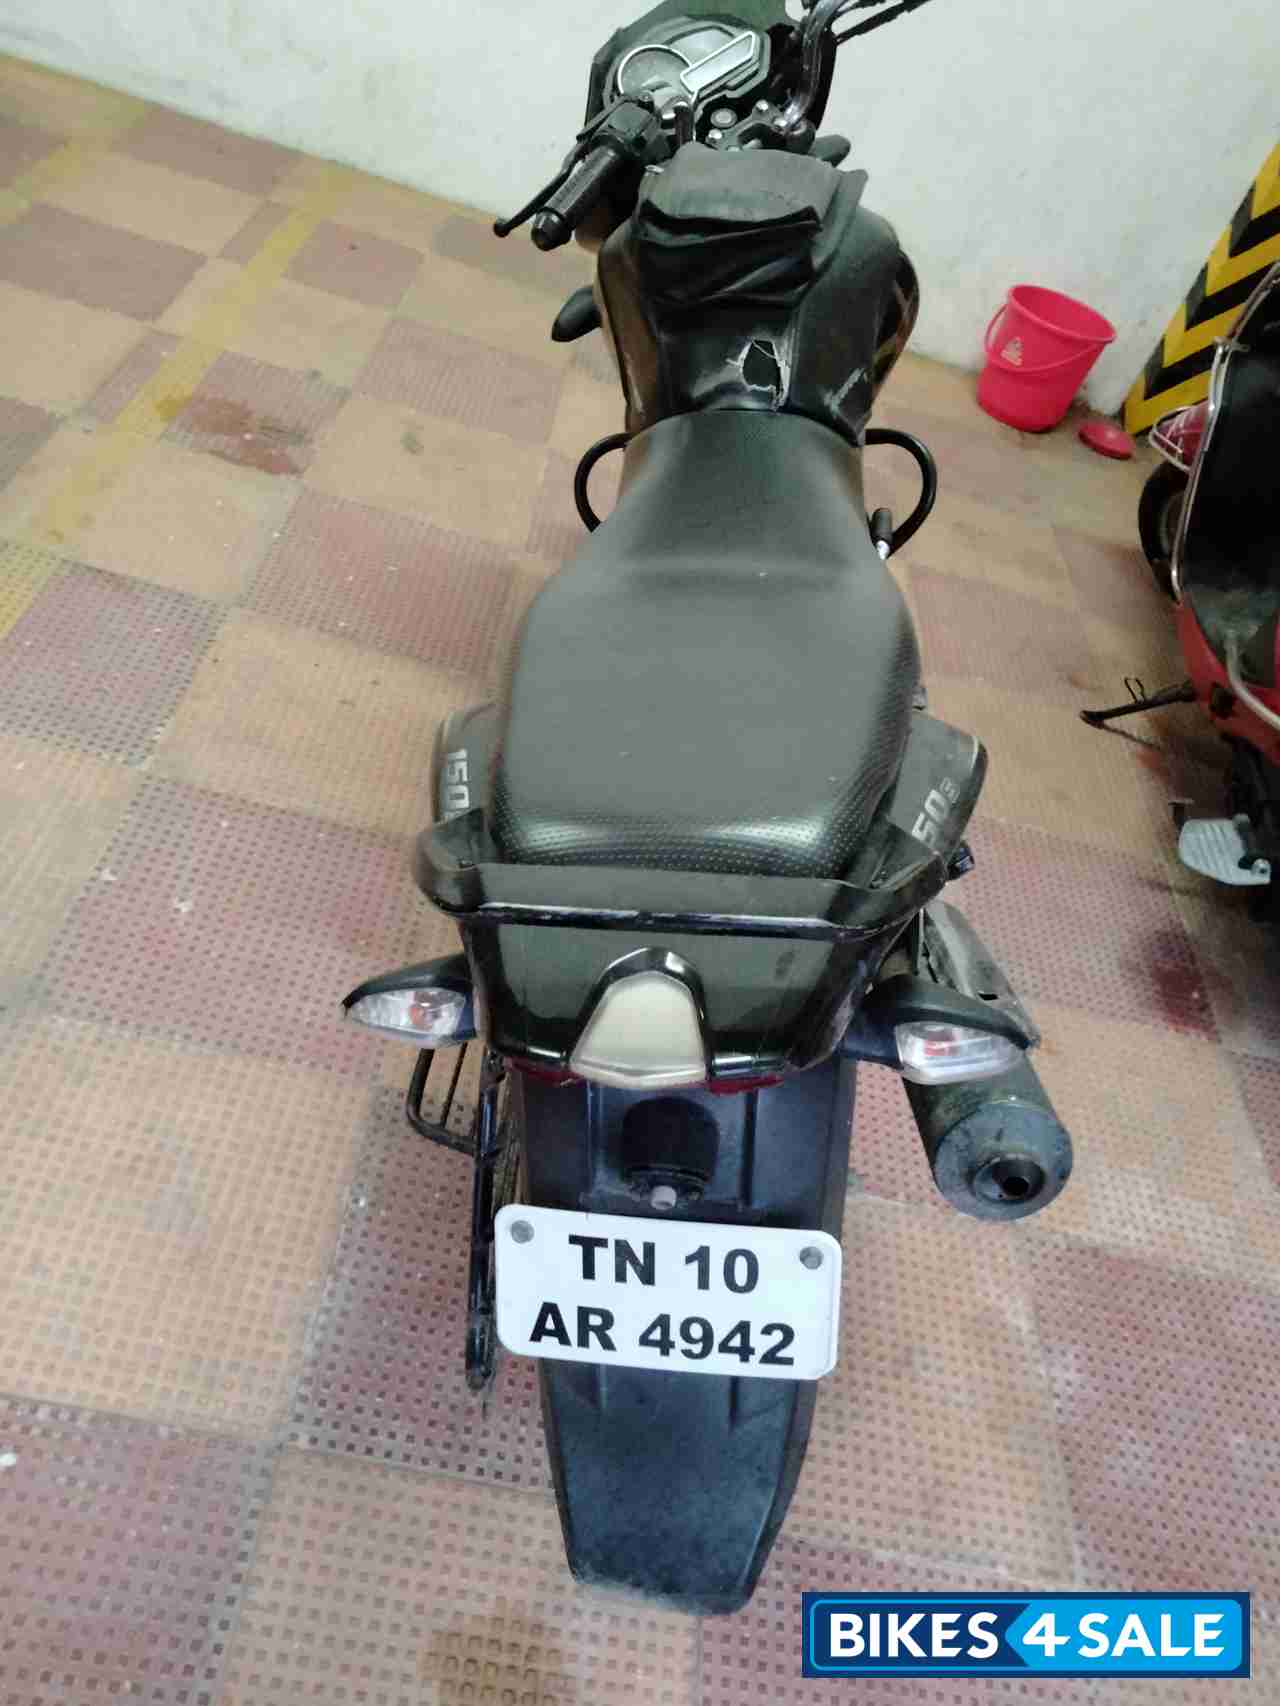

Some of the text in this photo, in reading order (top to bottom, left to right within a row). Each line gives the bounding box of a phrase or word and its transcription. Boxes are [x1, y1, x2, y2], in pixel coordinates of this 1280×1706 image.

[446, 749, 470, 820] 150
[568, 1234, 760, 1294] TN 10
[529, 1301, 796, 1367] AR 4942
